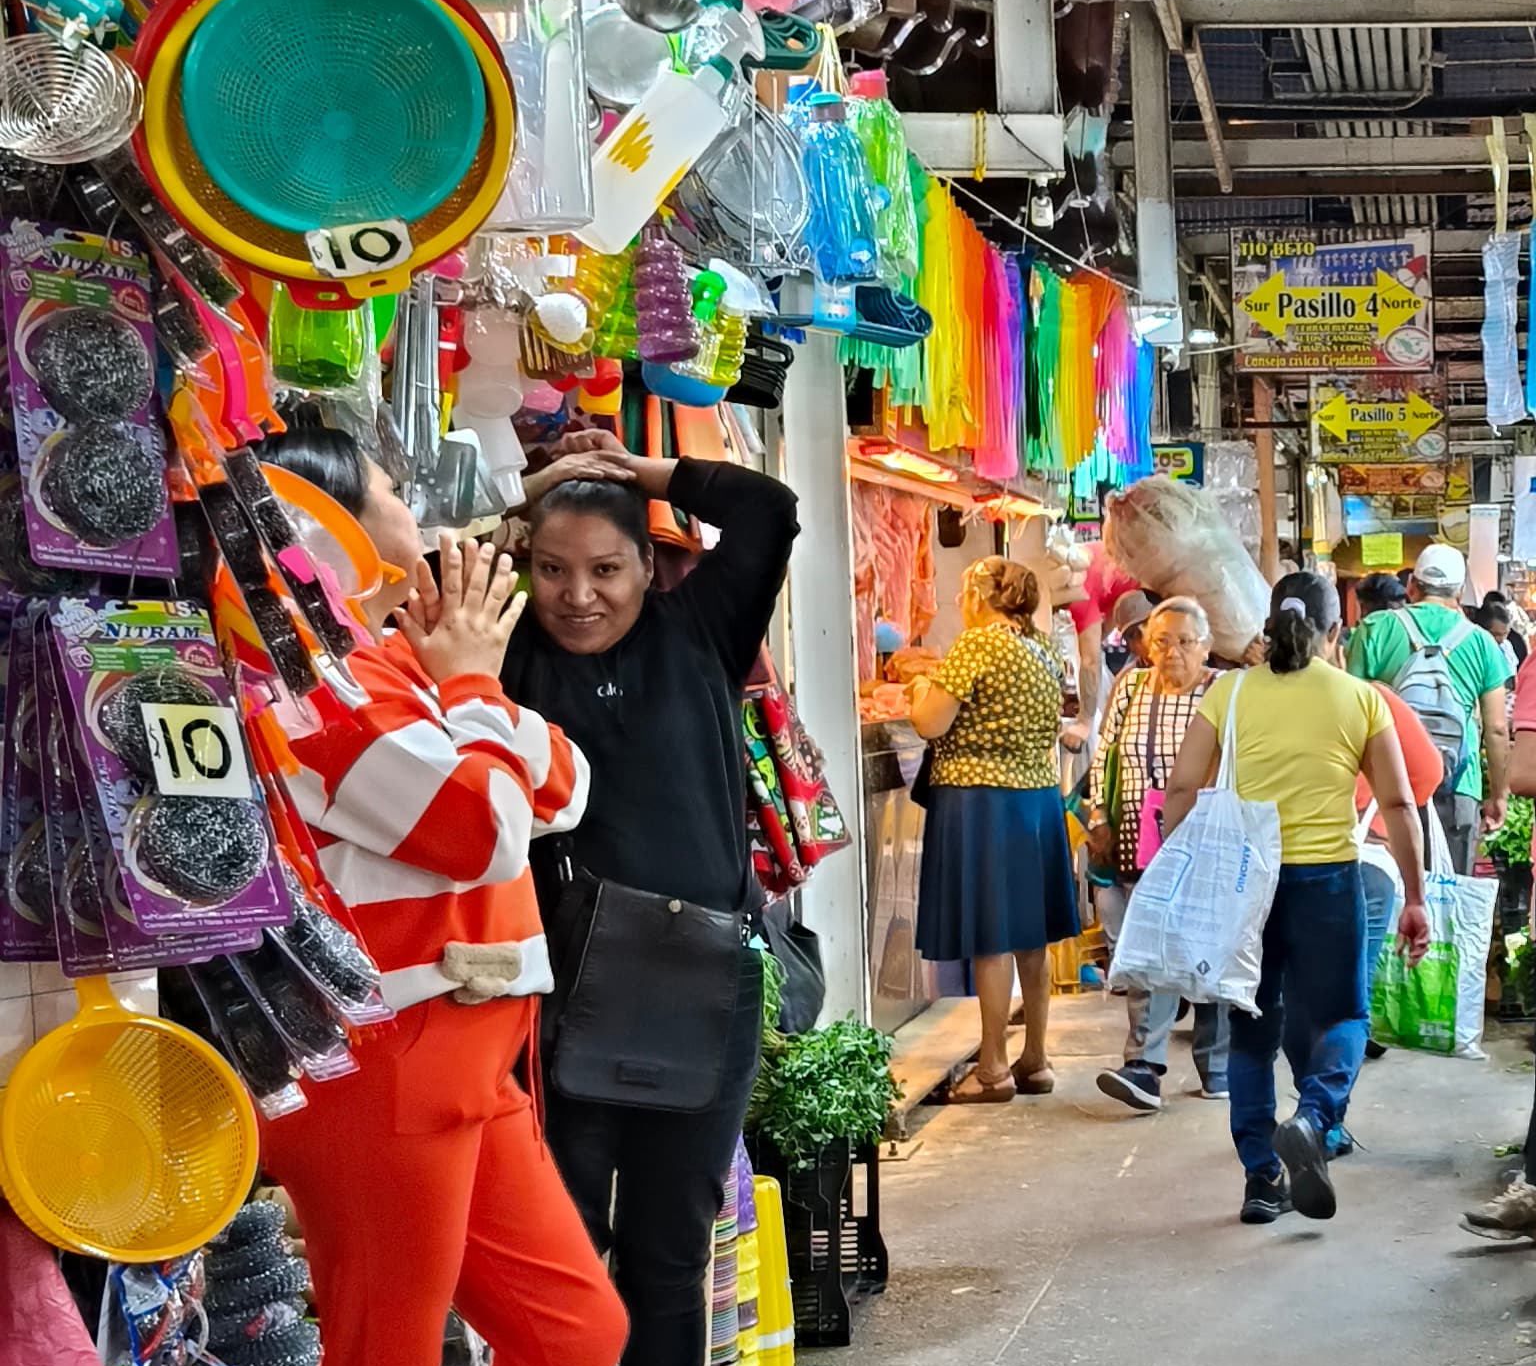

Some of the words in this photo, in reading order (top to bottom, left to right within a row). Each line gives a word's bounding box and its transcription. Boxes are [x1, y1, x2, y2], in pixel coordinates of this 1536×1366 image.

[1244, 299, 1271, 313] Sur
[1277, 292, 1357, 319] Pasillo
[1365, 292, 1379, 318] 4
[1380, 296, 1422, 310] Norte
[1350, 406, 1394, 423] Pasillo
[1397, 406, 1407, 422] 5
[1411, 410, 1441, 420] Norte
[103, 621, 201, 640] NITRAM
